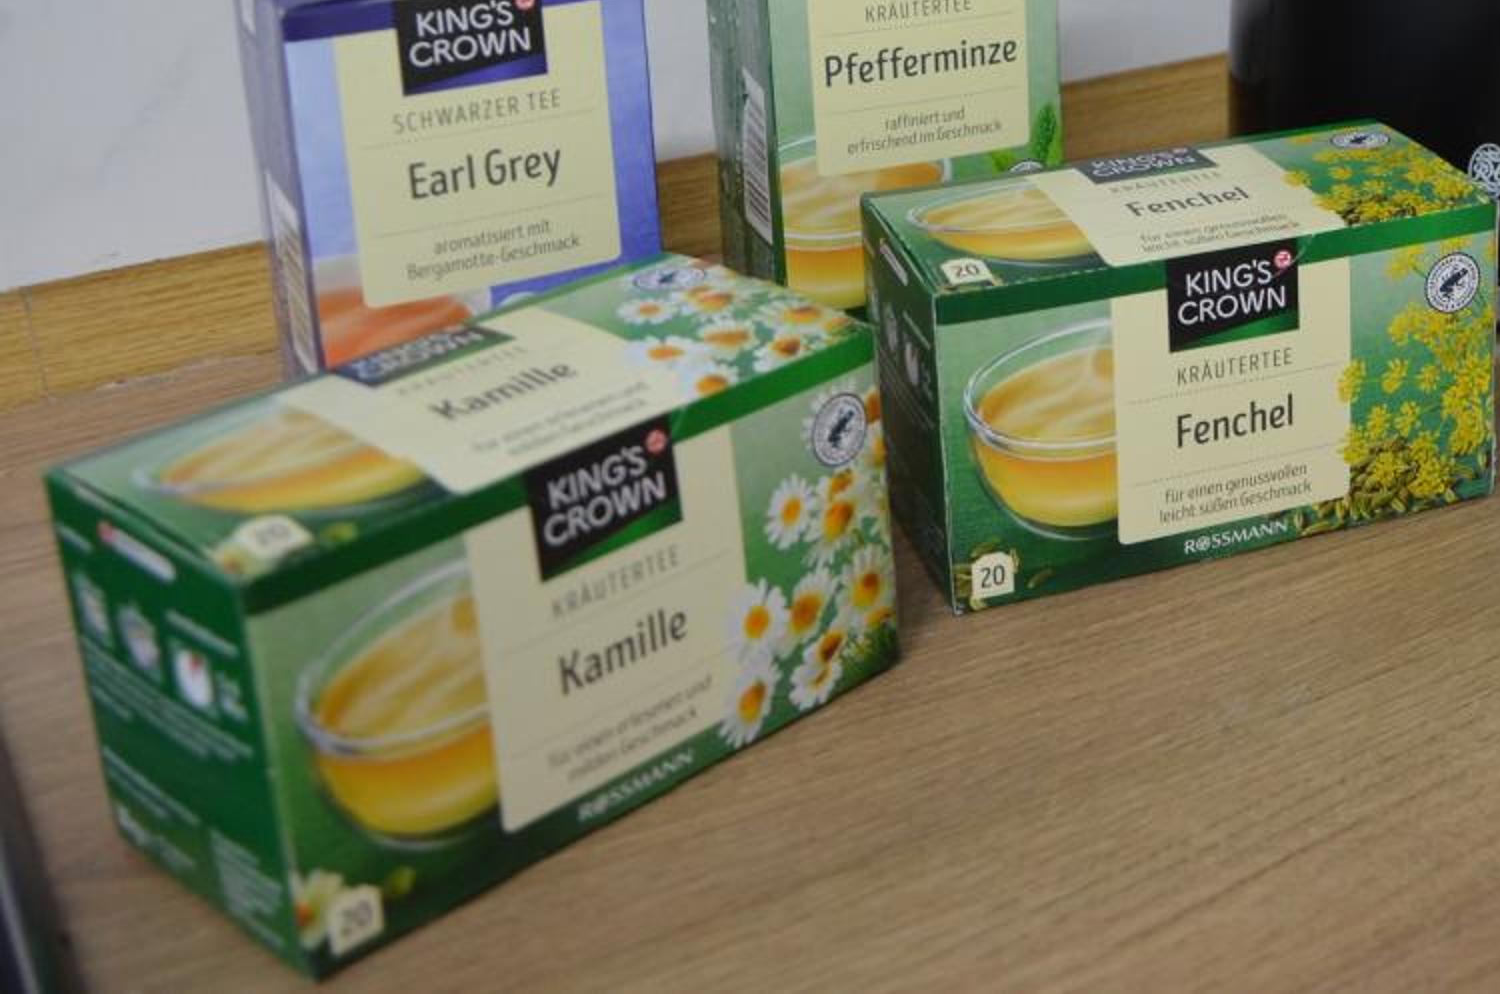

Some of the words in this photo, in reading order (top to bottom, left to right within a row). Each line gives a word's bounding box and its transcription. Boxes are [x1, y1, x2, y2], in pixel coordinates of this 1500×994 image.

[409, 26, 532, 67] CROWN
[824, 38, 1017, 88] Pfefferminze
[391, 95, 520, 135] SCHWARZER
[525, 88, 561, 110] TEE
[942, 105, 965, 122] und
[408, 154, 477, 200] Earl
[484, 148, 562, 188] Grey
[1126, 186, 1250, 218] Fenchel
[406, 231, 582, 282] Bergamotte-Geschmack
[433, 223, 525, 255] aromatisiert
[527, 218, 551, 239] mit
[950, 264, 980, 278] 20
[1185, 258, 1273, 298] KING'S
[1177, 285, 1288, 325] CROWN
[1176, 347, 1293, 387] KRÄUTERTEE
[429, 361, 577, 421] Kamille
[1176, 391, 1293, 449] Fenchel
[547, 445, 648, 510] KING'S
[1224, 462, 1308, 495] genussvollen
[1240, 478, 1312, 507] Geschmack
[543, 471, 667, 546] CROWN
[979, 564, 1006, 589] 20
[558, 608, 688, 696] Kamille
